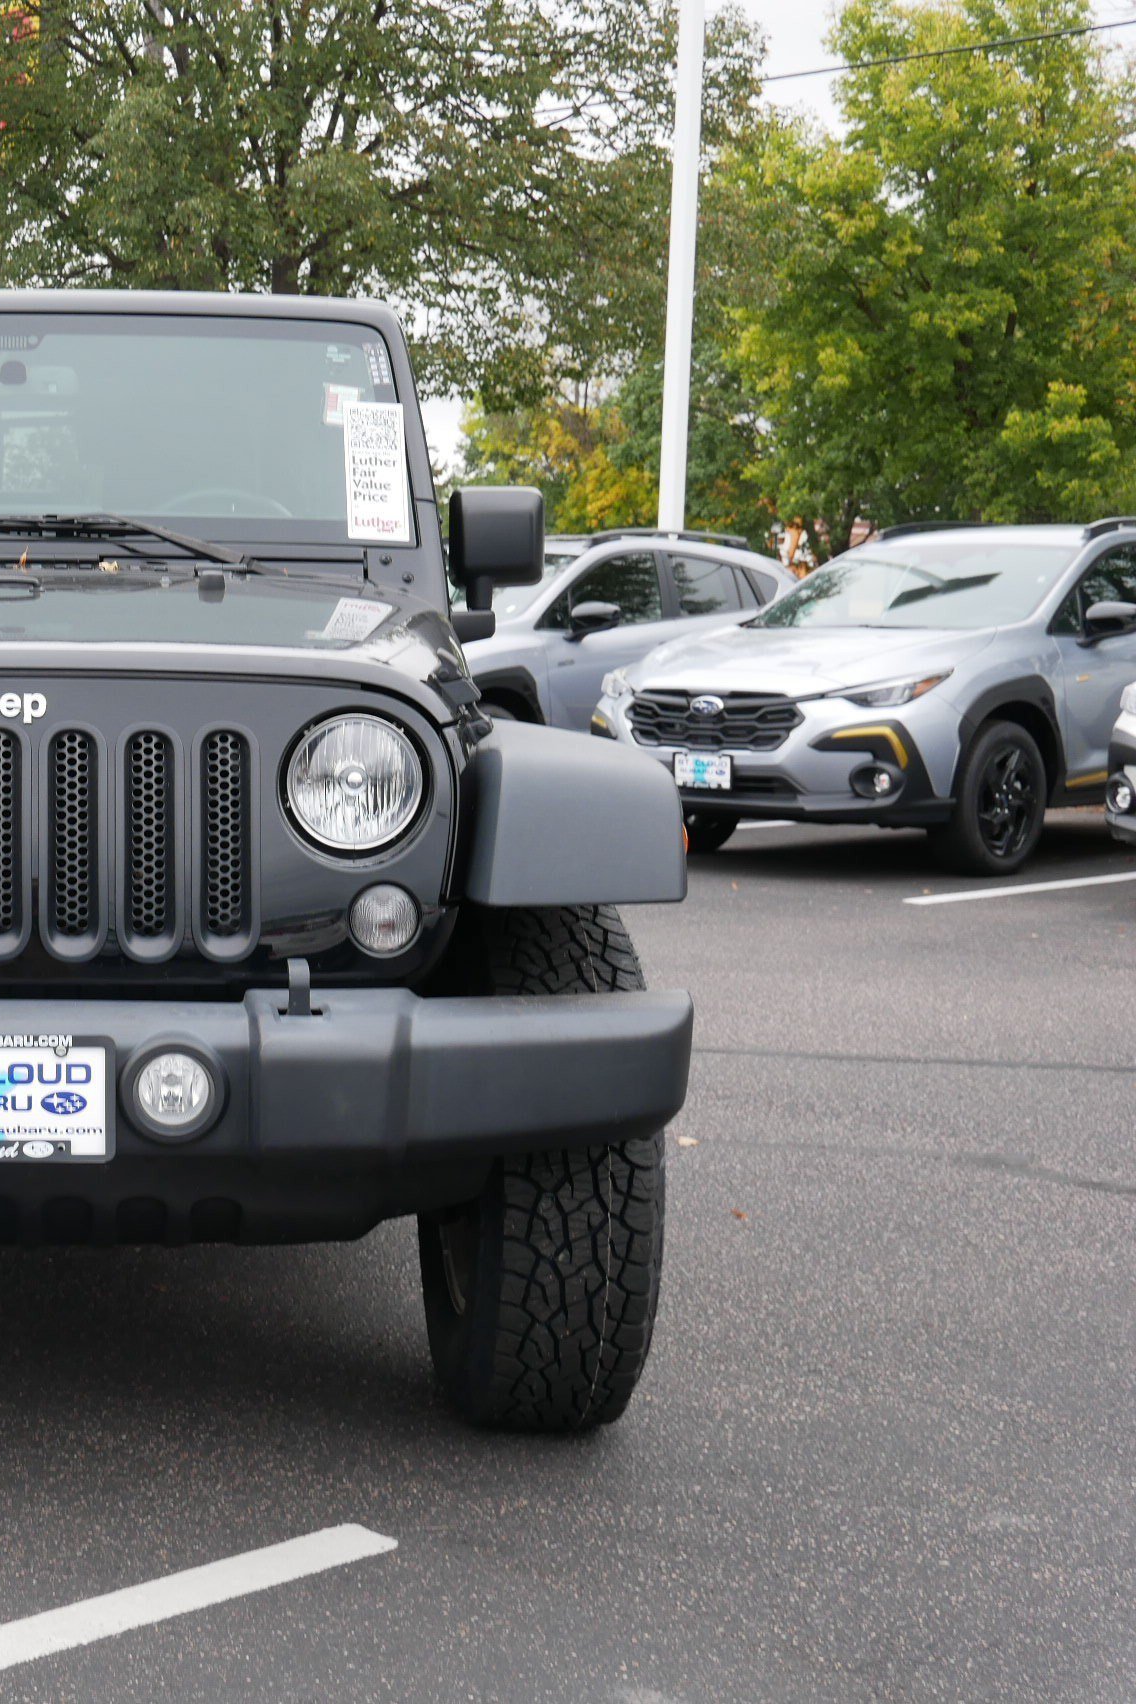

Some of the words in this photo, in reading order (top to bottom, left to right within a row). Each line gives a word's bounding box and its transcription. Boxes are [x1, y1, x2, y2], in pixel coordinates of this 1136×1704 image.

[352, 456, 397, 467] Luther
[353, 467, 377, 477] Fair
[353, 479, 392, 490] Value
[354, 491, 388, 503] Price
